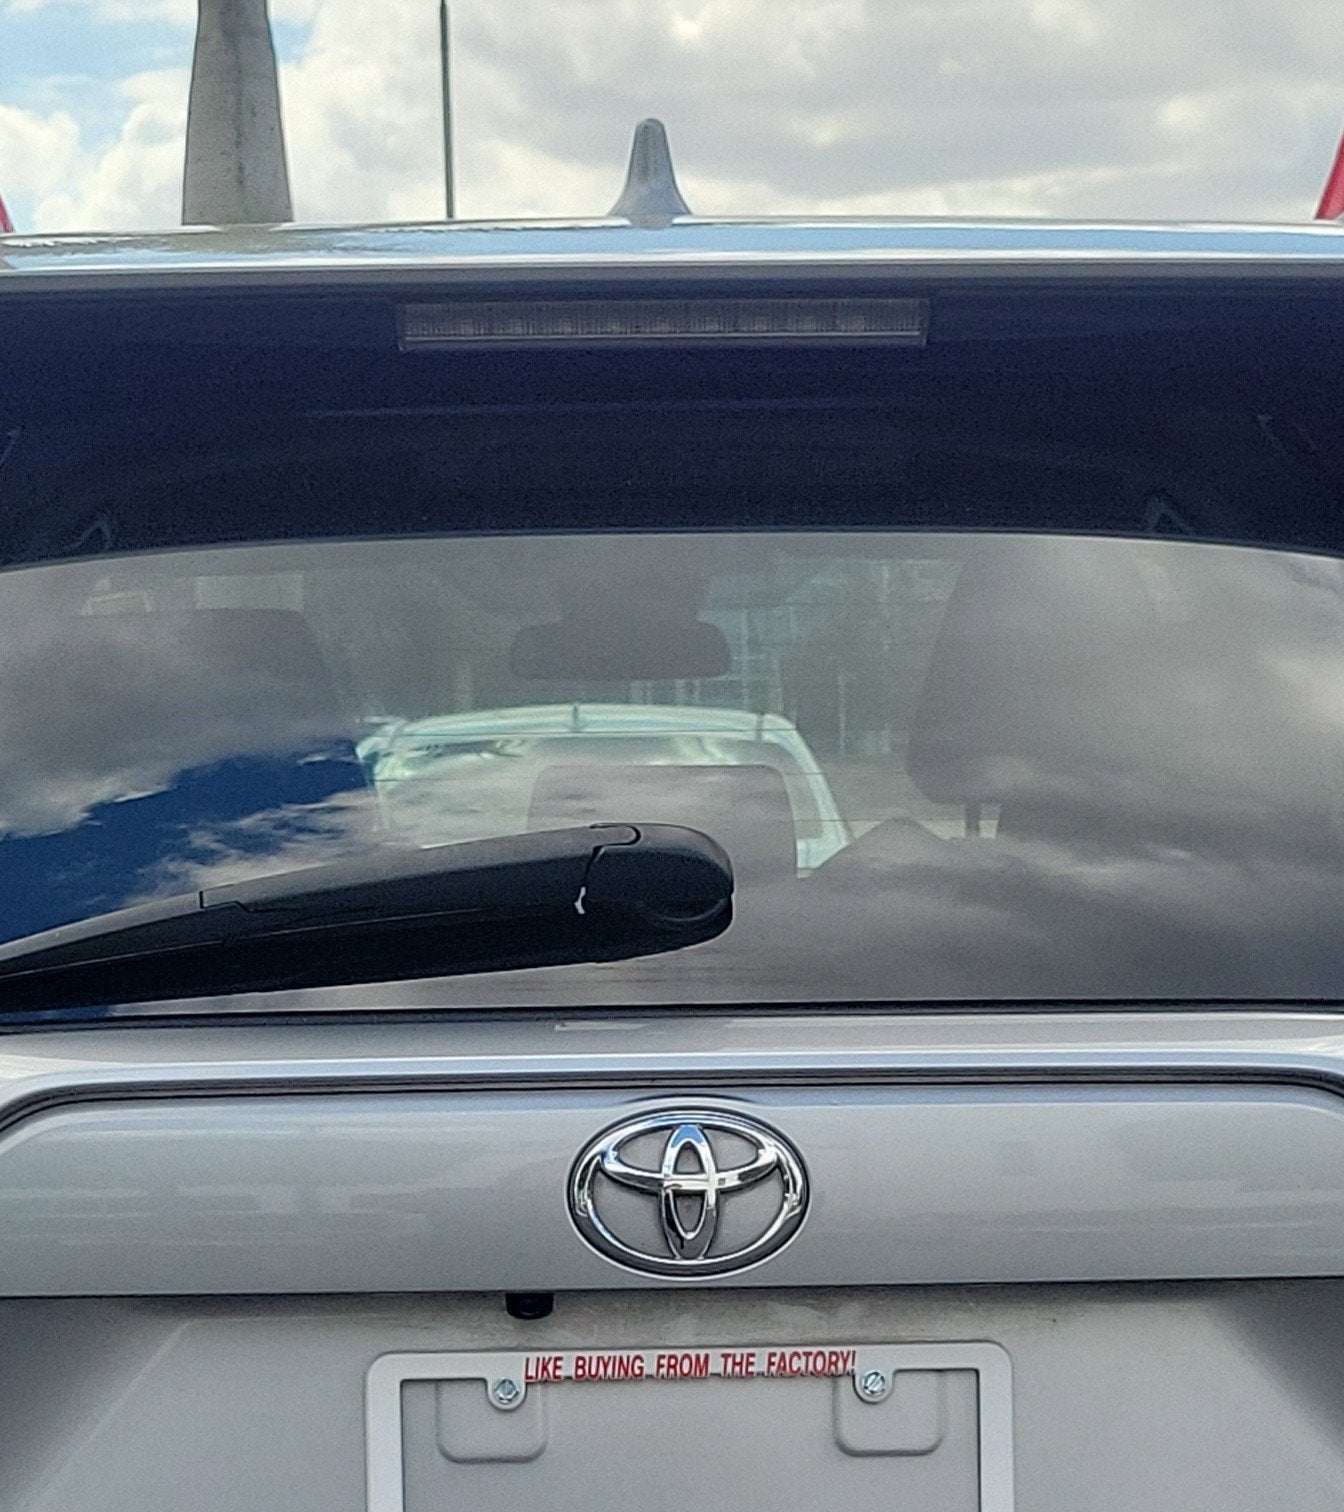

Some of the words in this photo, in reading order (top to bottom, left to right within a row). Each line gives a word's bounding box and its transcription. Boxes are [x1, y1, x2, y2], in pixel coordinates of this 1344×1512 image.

[525, 1355, 563, 1381] LIKE
[573, 1355, 645, 1379] BUYING
[656, 1353, 709, 1377] FROM
[721, 1352, 756, 1376] THE
[766, 1350, 856, 1376] FACTORY!
